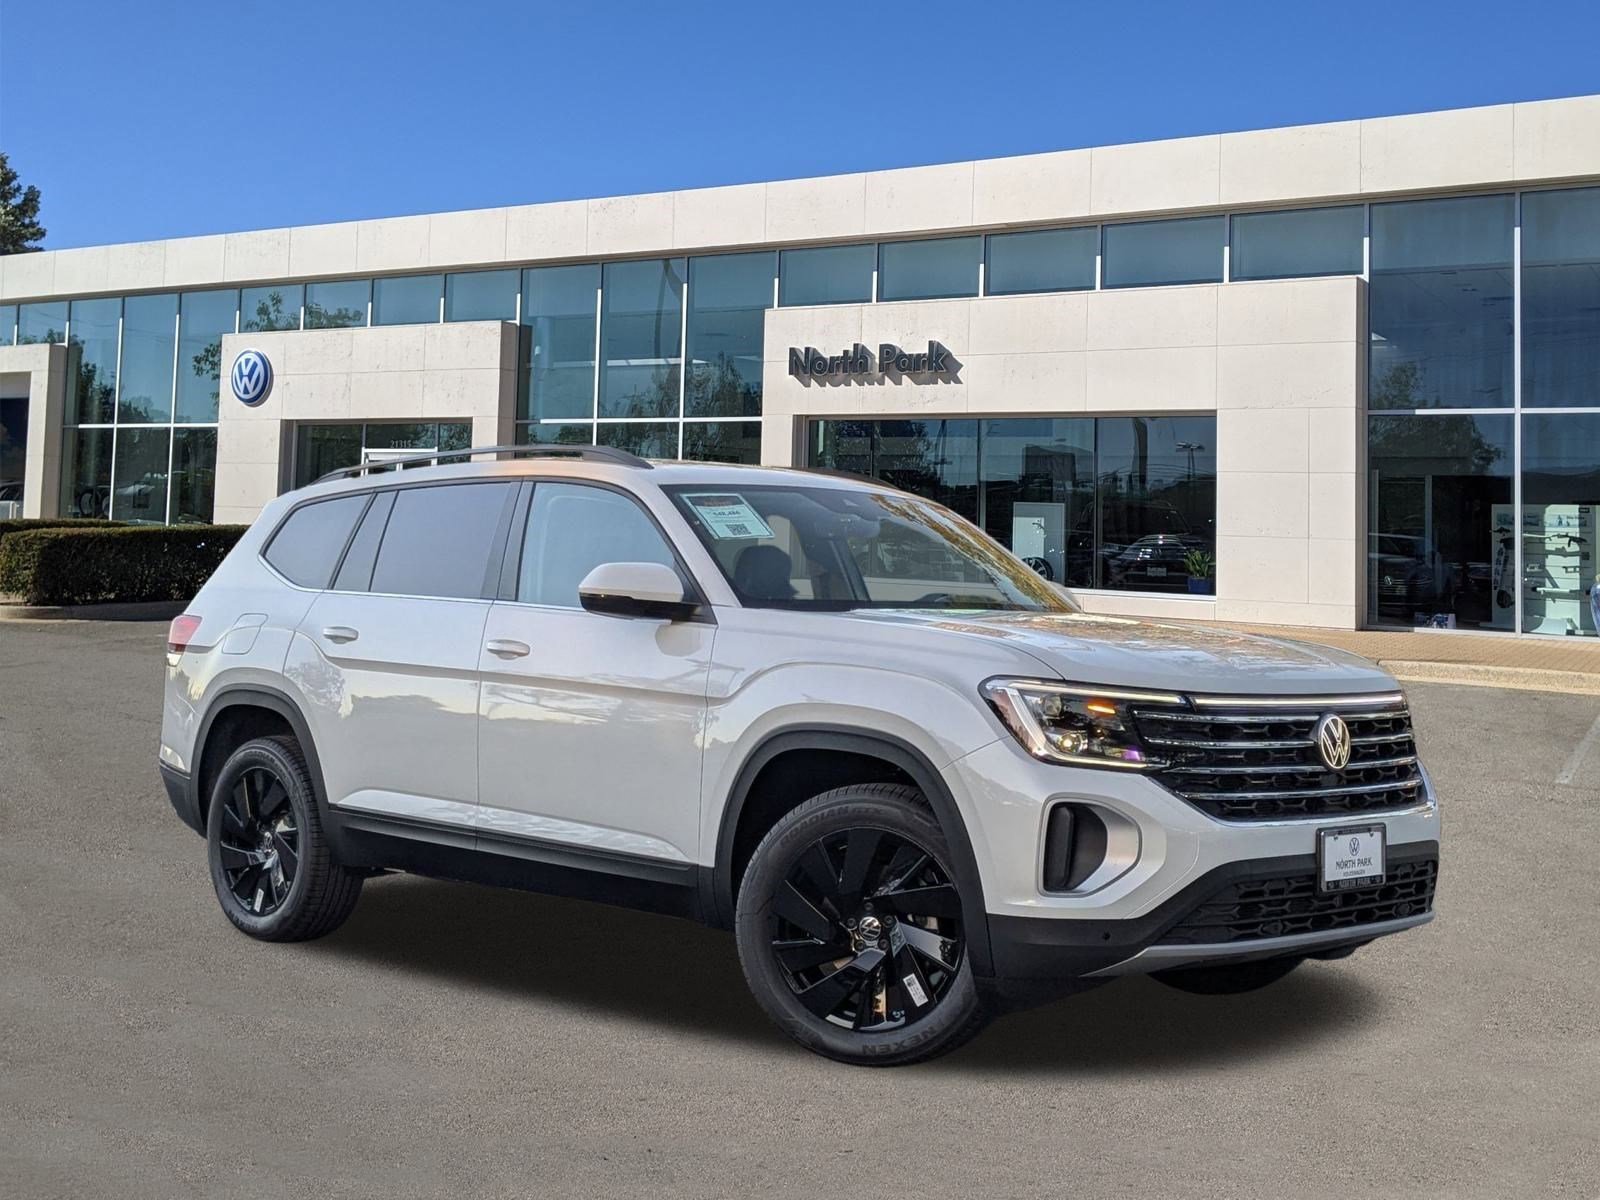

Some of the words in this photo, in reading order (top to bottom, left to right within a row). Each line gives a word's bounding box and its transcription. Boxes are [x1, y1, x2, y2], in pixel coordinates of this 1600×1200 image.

[789, 343, 871, 376] North
[879, 340, 947, 373] Park
[1336, 859, 1356, 870] NORTH
[1357, 857, 1373, 867] PARK
